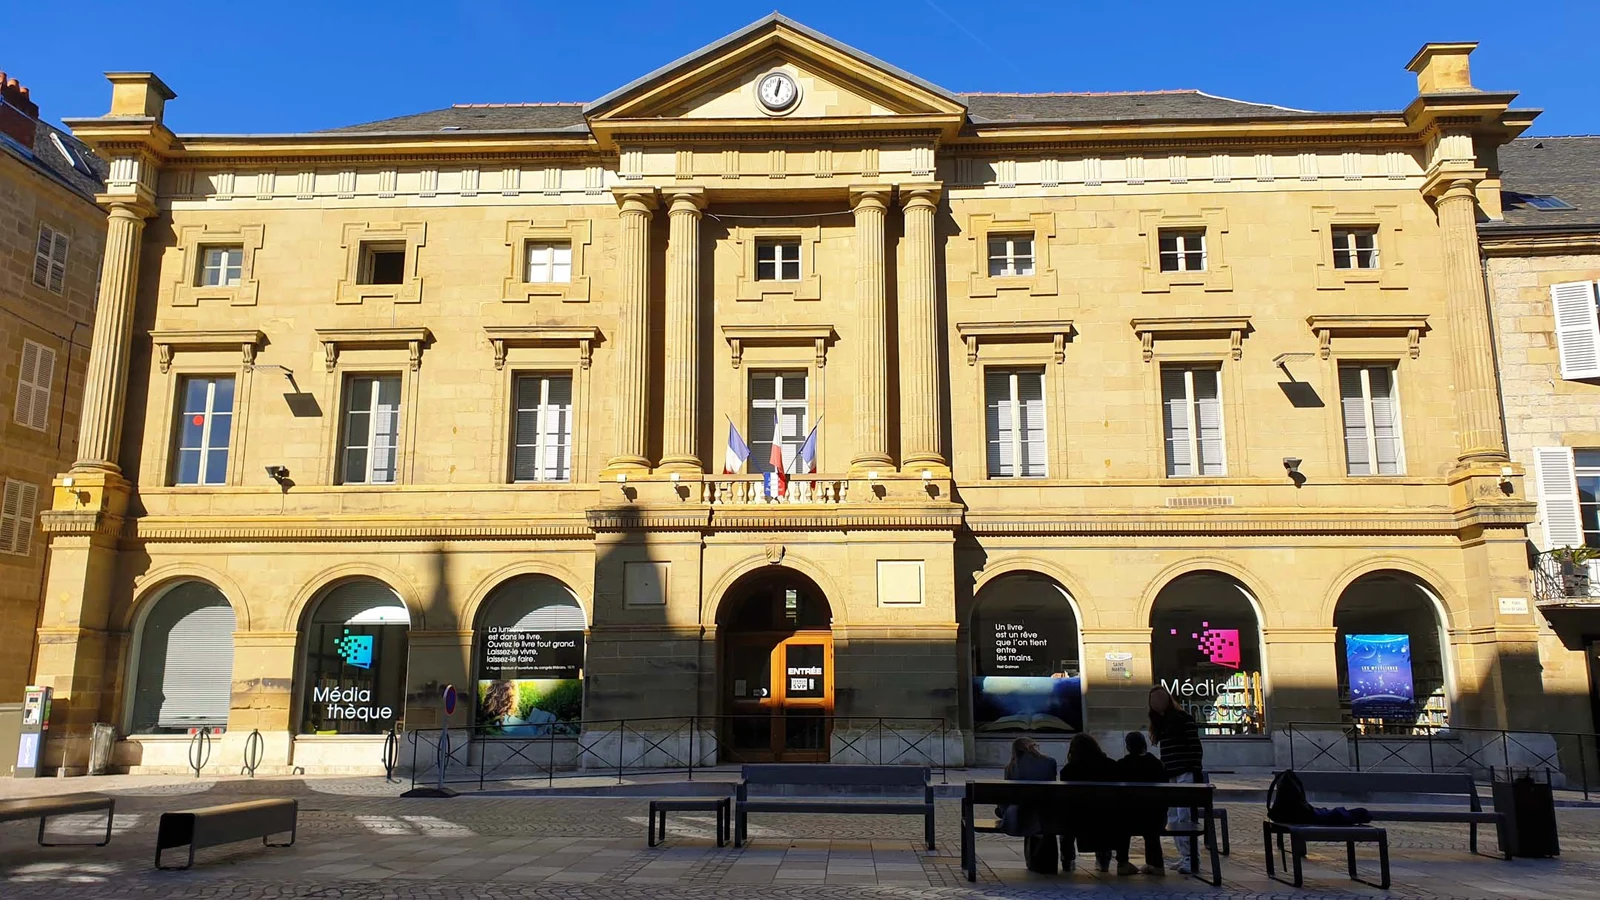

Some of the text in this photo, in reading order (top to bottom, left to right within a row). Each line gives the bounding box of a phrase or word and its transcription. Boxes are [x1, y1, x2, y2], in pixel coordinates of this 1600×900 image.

[995, 623, 1023, 631] Un livre
[552, 640, 576, 649] grand.
[788, 666, 822, 675] ENTRÉE
[314, 686, 370, 702] Média
[1160, 679, 1228, 697] Média
[327, 704, 392, 722] thèque
